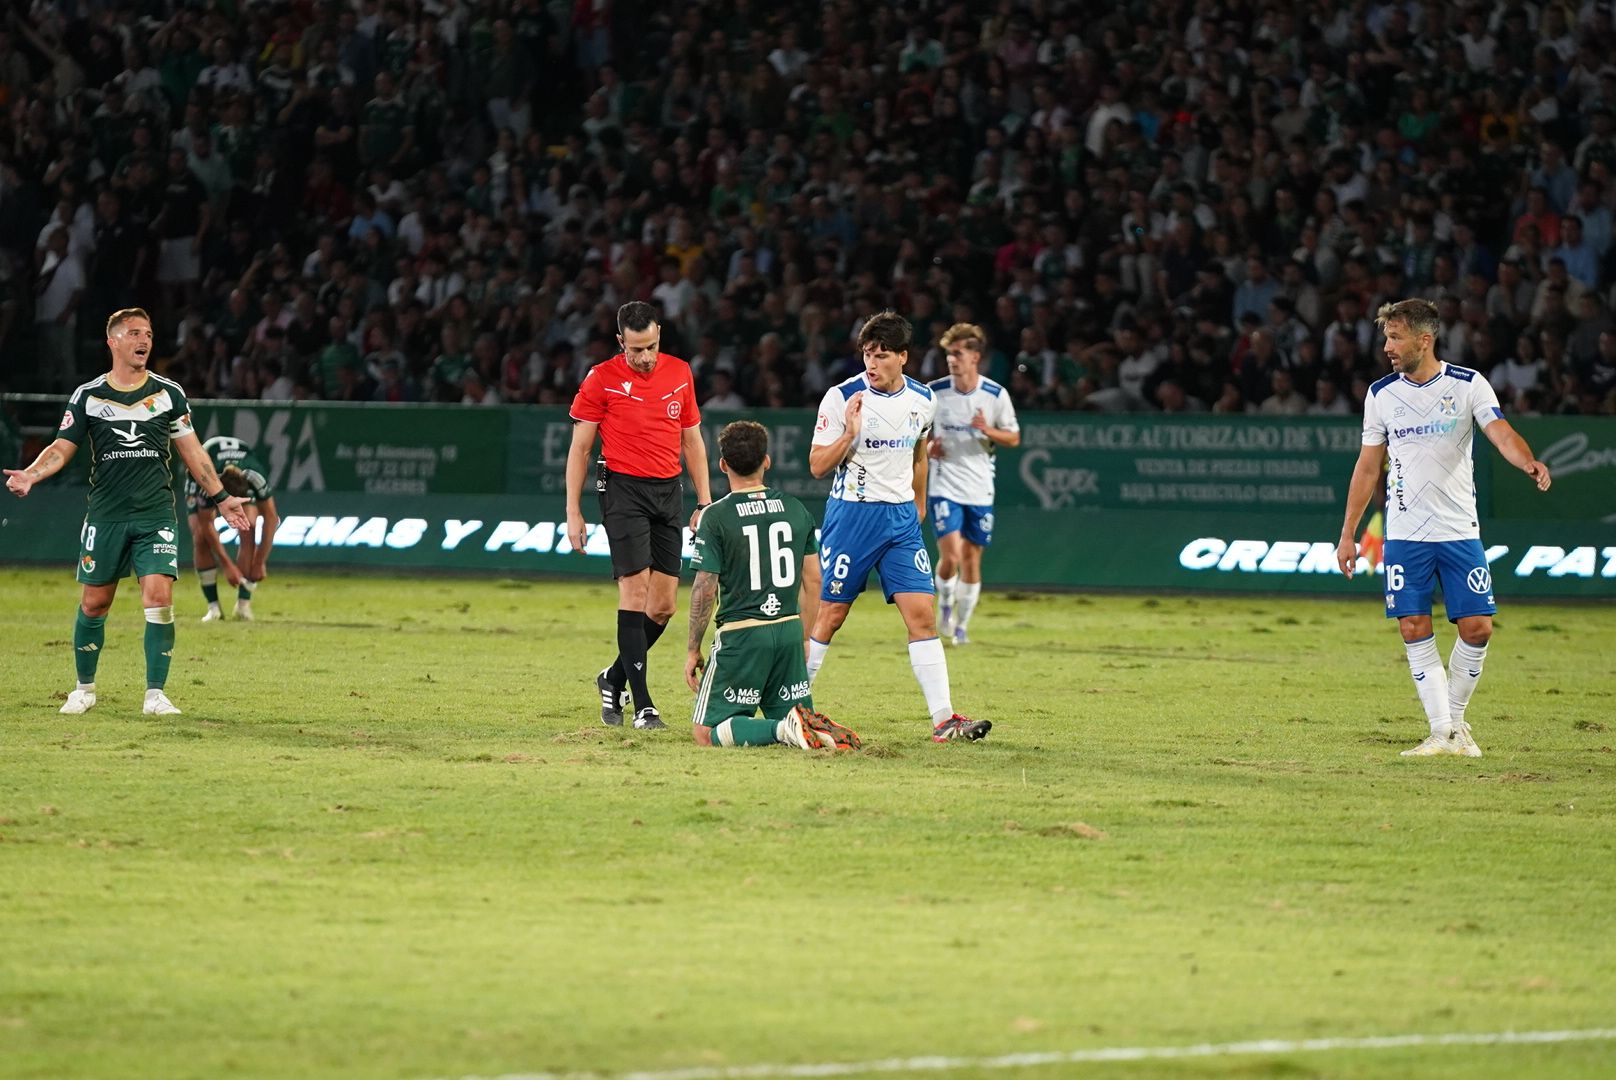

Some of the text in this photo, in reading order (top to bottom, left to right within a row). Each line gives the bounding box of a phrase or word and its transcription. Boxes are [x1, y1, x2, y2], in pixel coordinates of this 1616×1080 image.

[1024, 424, 1362, 449] DESGUACE AUTORIZADO DE VEH
[736, 501, 766, 517] DIEGO
[441, 519, 483, 550] Y
[742, 521, 795, 591] 16
[834, 554, 850, 579] 6
[1386, 564, 1405, 592] 16
[738, 688, 760, 697] MÁS
[791, 681, 808, 692] MÁS
